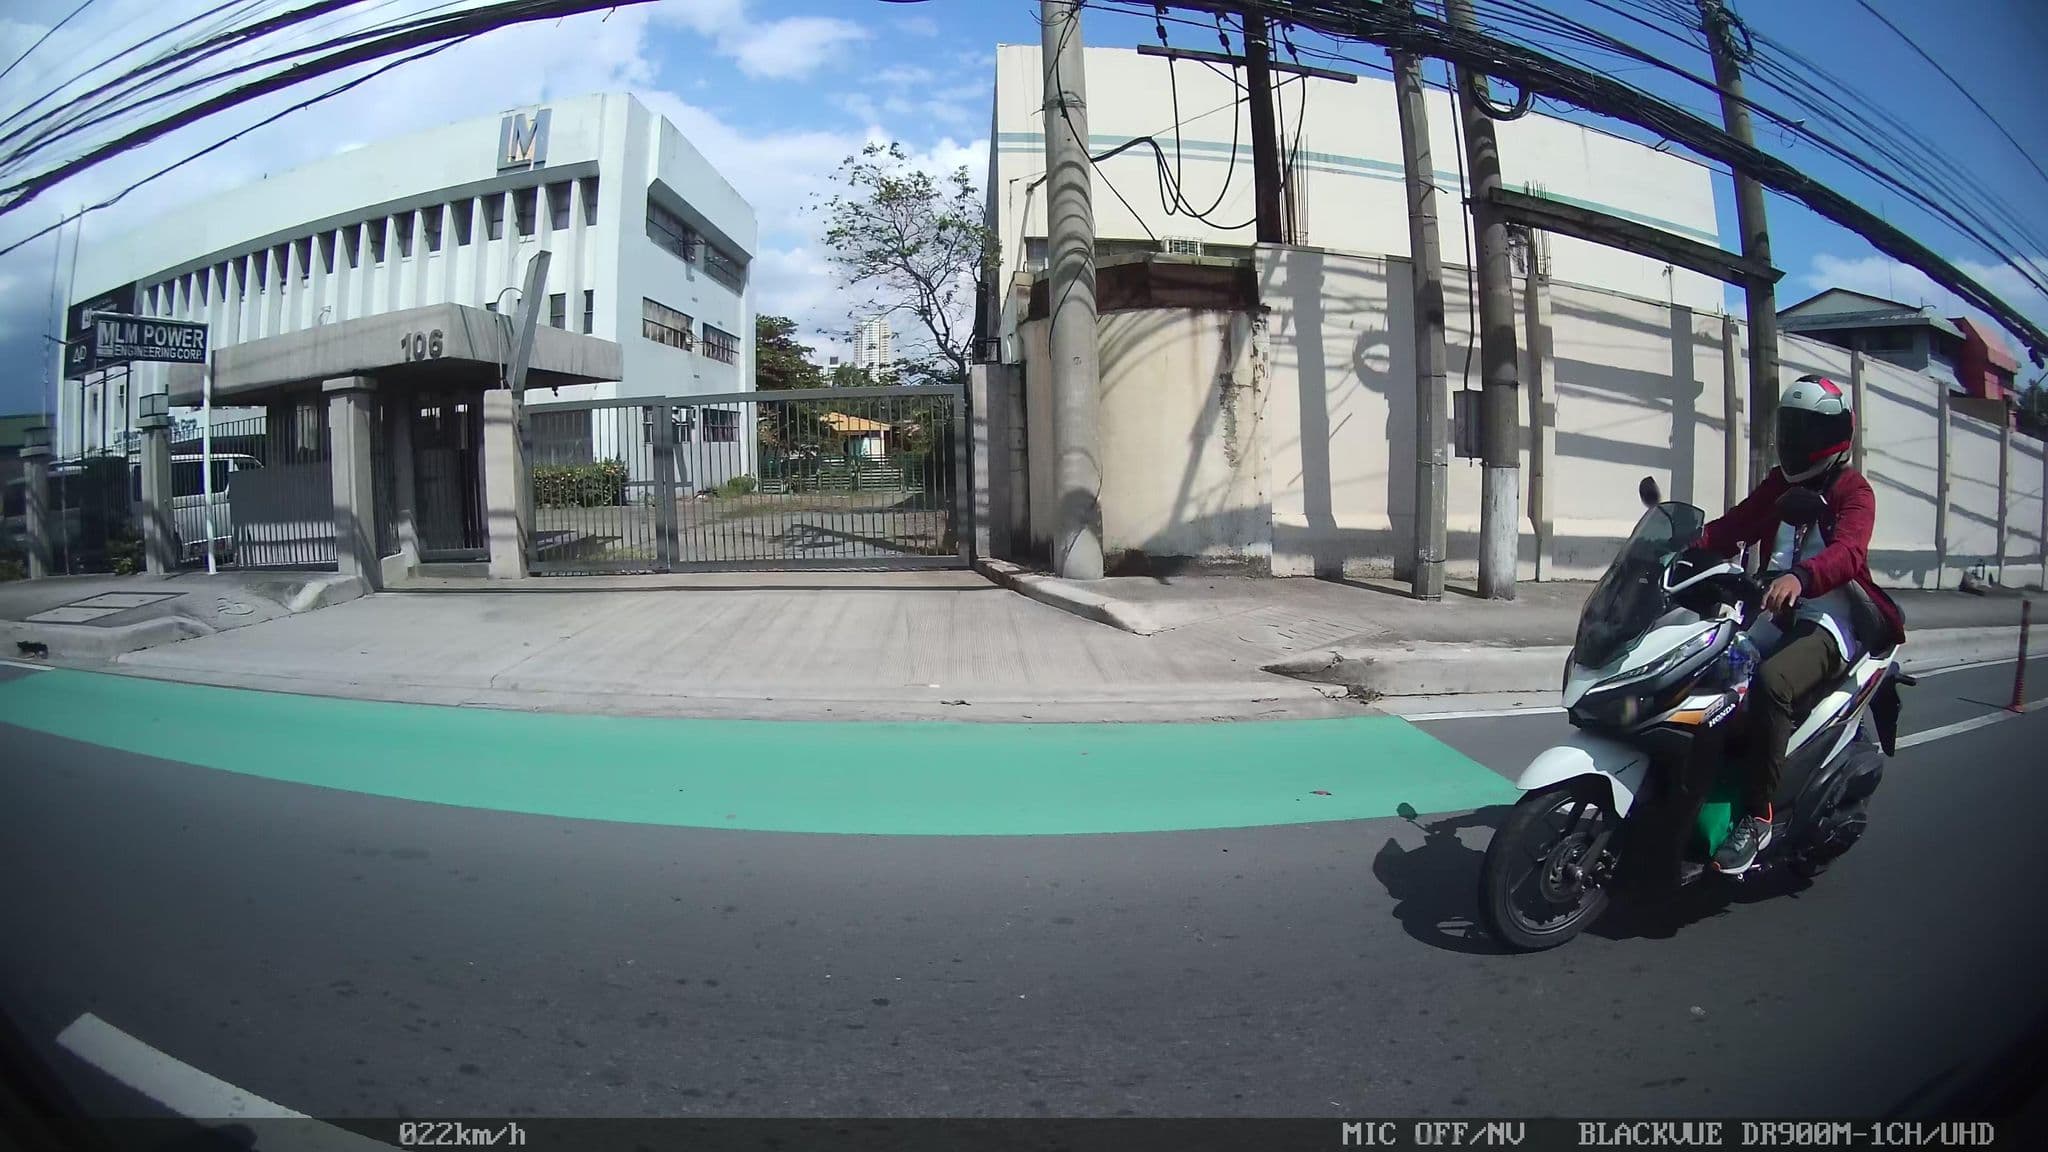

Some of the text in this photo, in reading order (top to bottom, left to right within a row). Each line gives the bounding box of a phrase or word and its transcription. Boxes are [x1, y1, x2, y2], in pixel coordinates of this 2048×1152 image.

[144, 325, 204, 348] POWER
[401, 329, 443, 361] 106
[1708, 703, 1736, 728] HONDA
